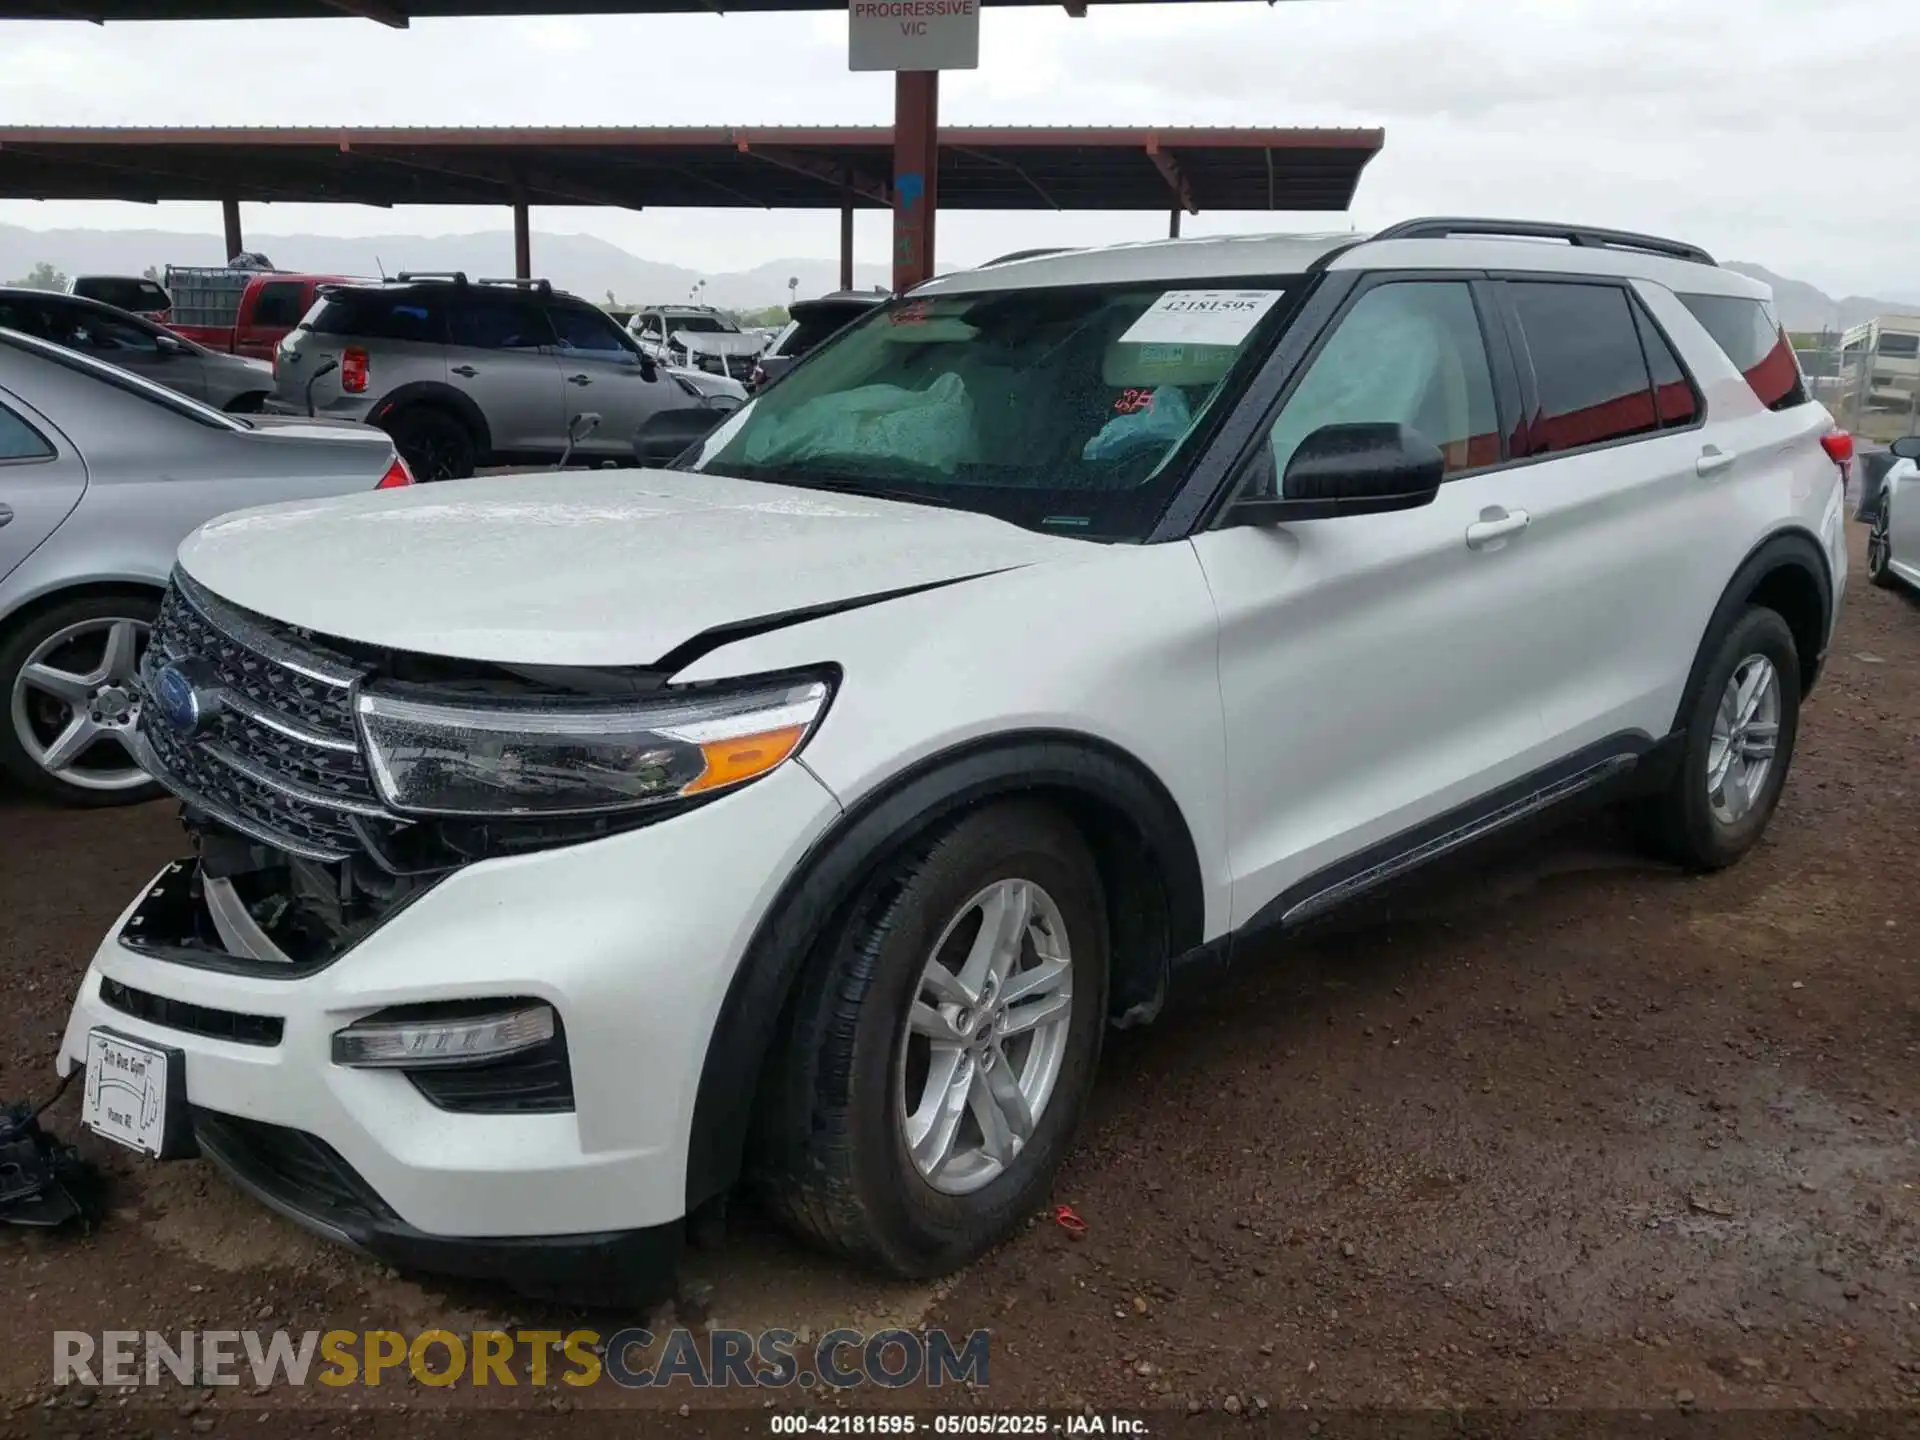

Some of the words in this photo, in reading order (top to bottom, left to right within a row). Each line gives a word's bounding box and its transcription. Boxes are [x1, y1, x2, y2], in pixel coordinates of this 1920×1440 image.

[855, 1, 973, 17] PROGRESSIVE
[900, 22, 928, 36] VIC
[1161, 301, 1258, 313] 42181595
